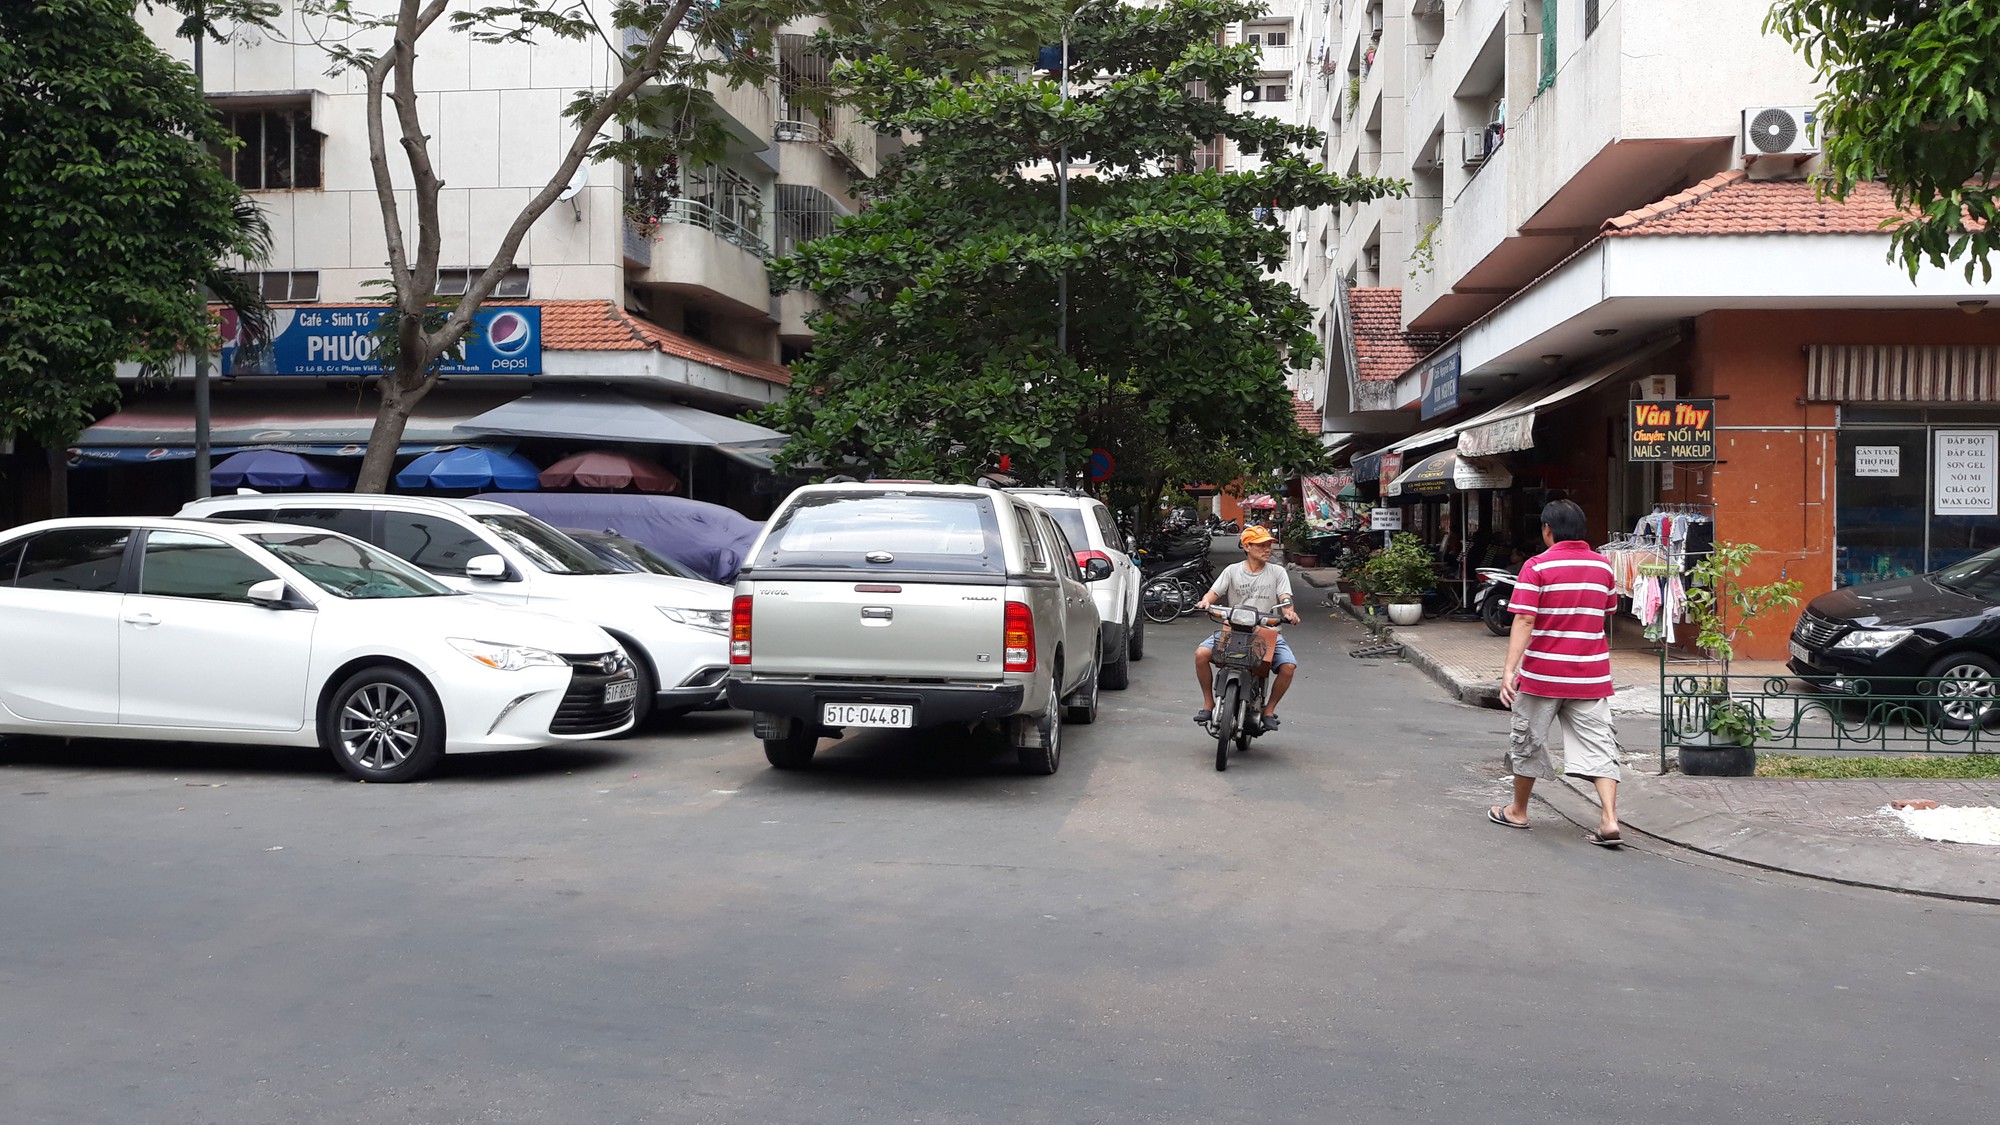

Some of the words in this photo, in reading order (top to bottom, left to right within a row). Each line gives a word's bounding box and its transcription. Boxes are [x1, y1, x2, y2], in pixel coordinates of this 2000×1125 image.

[300, 313, 322, 327] Café
[332, 312, 353, 327] Sinh
[355, 311, 371, 326] Tố
[341, 365, 361, 373] Phạm
[457, 364, 480, 372] Thạnh
[491, 357, 528, 370] pepsi
[1635, 404, 1671, 426] Vân
[1675, 403, 1710, 430] Thy
[1633, 429, 1666, 445] Chuyên:
[1667, 426, 1692, 442] NỐI
[1695, 430, 1711, 442] MI
[1967, 437, 1986, 446] BỘT
[1633, 445, 1661, 458] NAILS
[1671, 444, 1711, 458] MAKEUP
[1967, 449, 1986, 457] GEL
[1946, 461, 1965, 469] SƠN
[1967, 461, 1986, 469] GEL
[1417, 470, 1444, 479] Legend
[1965, 497, 1991, 505] LÔNG
[827, 706, 907, 725] 51C-044.81
